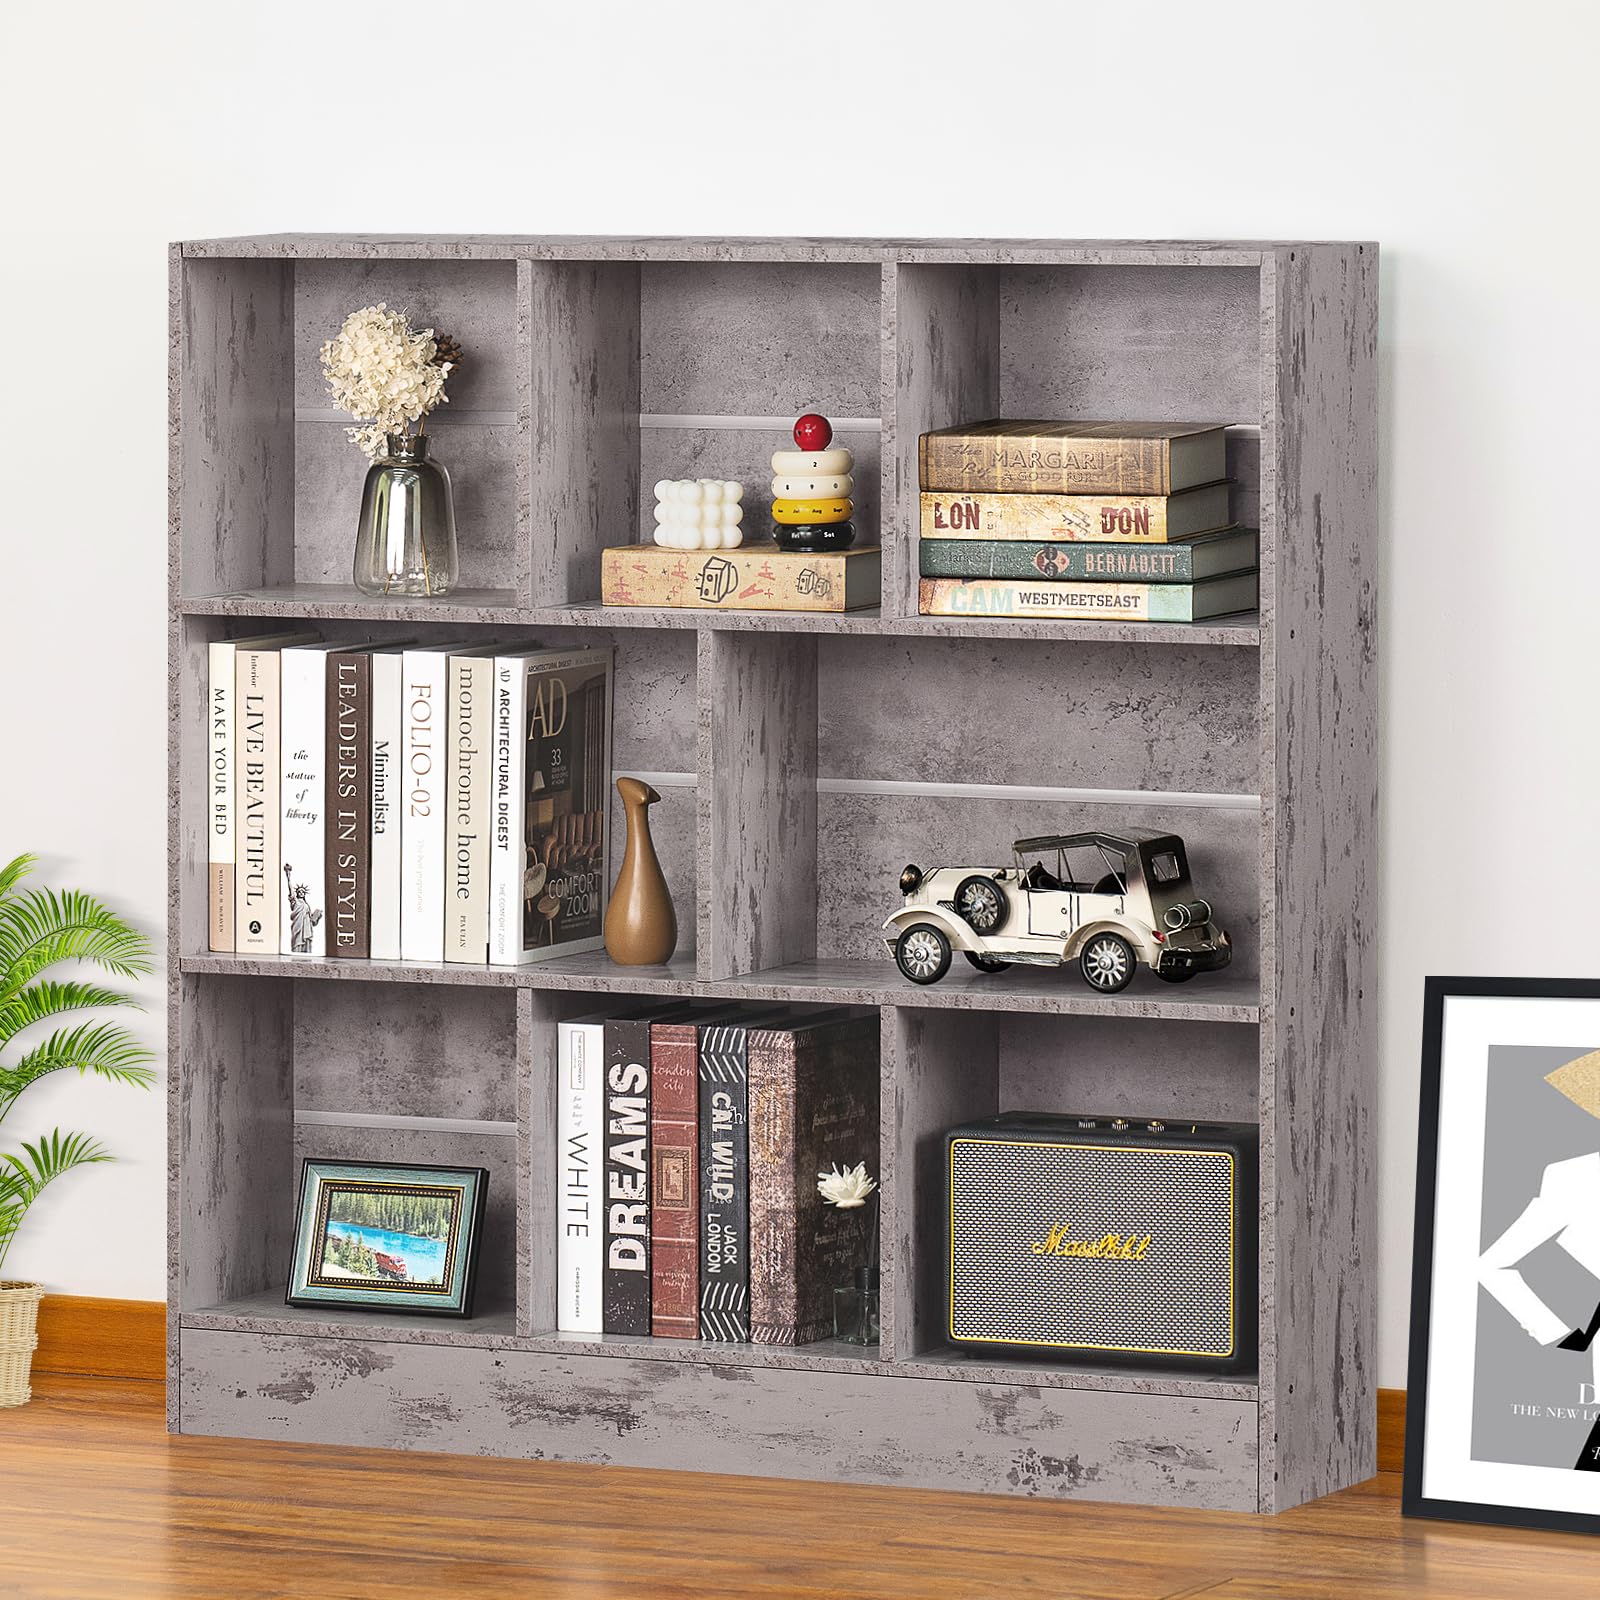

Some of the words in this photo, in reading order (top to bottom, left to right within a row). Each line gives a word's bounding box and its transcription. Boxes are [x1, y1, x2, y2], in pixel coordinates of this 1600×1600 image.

[934, 502, 980, 530] LON
[1101, 507, 1149, 535] DON
[1085, 553, 1176, 574] BERNADETT
[951, 587, 1015, 613] CAM
[1019, 592, 1141, 608] WESTMEETSEAST
[250, 656, 258, 688] Interior
[500, 667, 510, 683] AD
[214, 688, 225, 739] MAKE
[246, 695, 265, 754] LIVE
[528, 678, 567, 740] AD
[337, 664, 357, 799] LEADERS
[410, 683, 432, 818] FOLIO-02
[457, 667, 478, 825] monochrome
[498, 688, 510, 800] ARCHITECTURAL
[214, 747, 227, 796] YOUR
[293, 750, 308, 760] the
[551, 748, 561, 766] 33
[286, 772, 316, 780] statue
[295, 789, 309, 804] of
[374, 740, 390, 835] Minimalista
[215, 804, 227, 835] BED
[246, 762, 265, 906] BEAUTIFUL
[285, 808, 318, 825] liberty
[337, 810, 356, 842] IN
[497, 802, 509, 851] DIGEST
[457, 833, 477, 900] home
[548, 872, 601, 899] COMFORT
[337, 854, 357, 947] STYLE
[566, 893, 598, 917] ZOOM
[663, 1079, 684, 1095] city
[712, 1091, 733, 1132] CAL
[567, 1132, 589, 1238] WHITE
[608, 1063, 648, 1272] DREAMS
[711, 1141, 735, 1200] WILD
[707, 1213, 721, 1273] LONDON
[724, 1225, 738, 1264] JACK
[1510, 1403, 1541, 1417] THE
[1546, 1407, 1579, 1419] NEW
